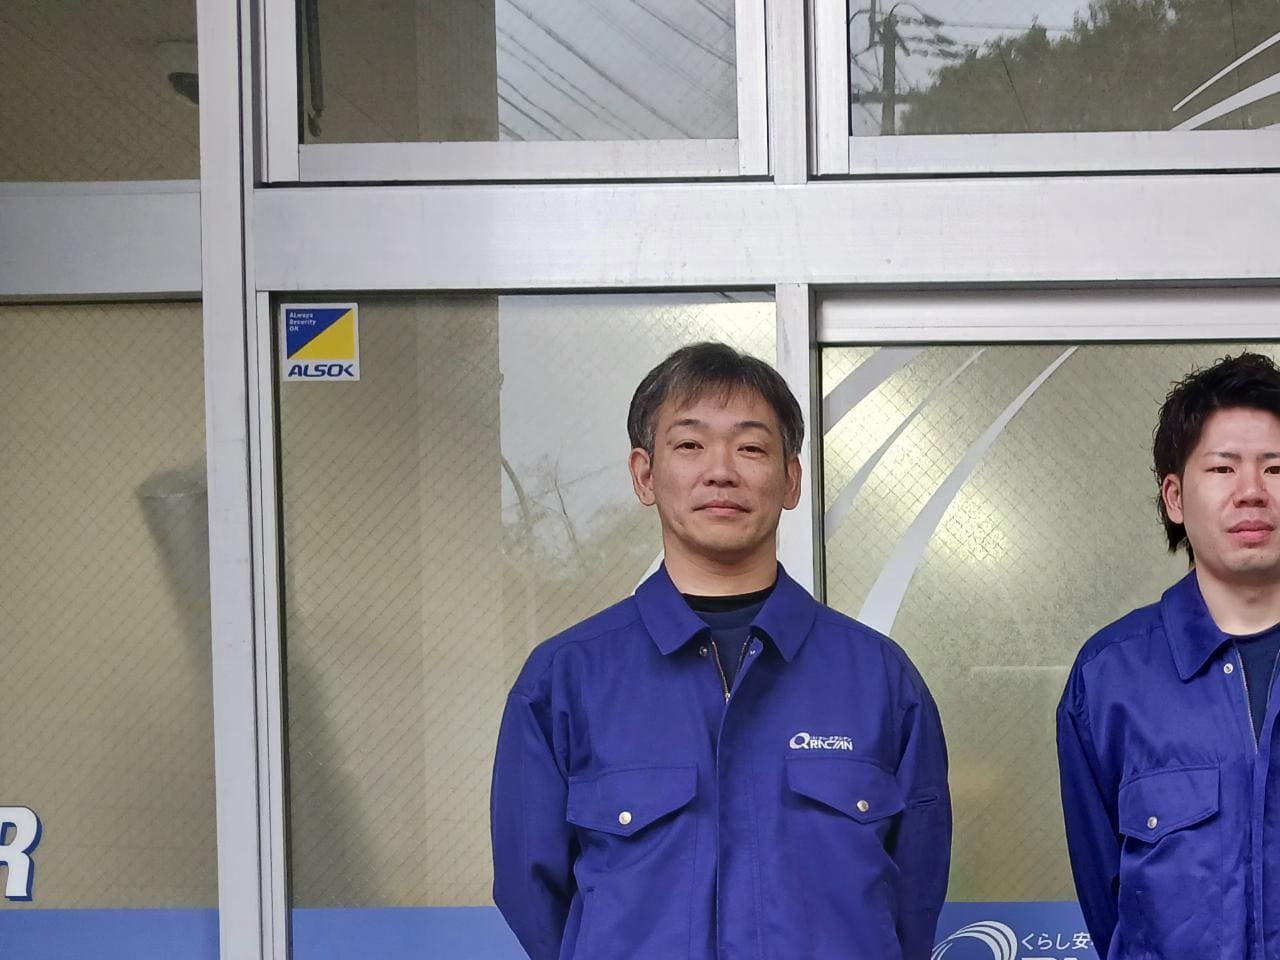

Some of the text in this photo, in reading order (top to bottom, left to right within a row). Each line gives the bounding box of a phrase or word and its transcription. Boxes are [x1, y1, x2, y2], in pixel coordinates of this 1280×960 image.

[288, 364, 354, 377] ALSOK
[1021, 932, 1094, 951] くらし安
